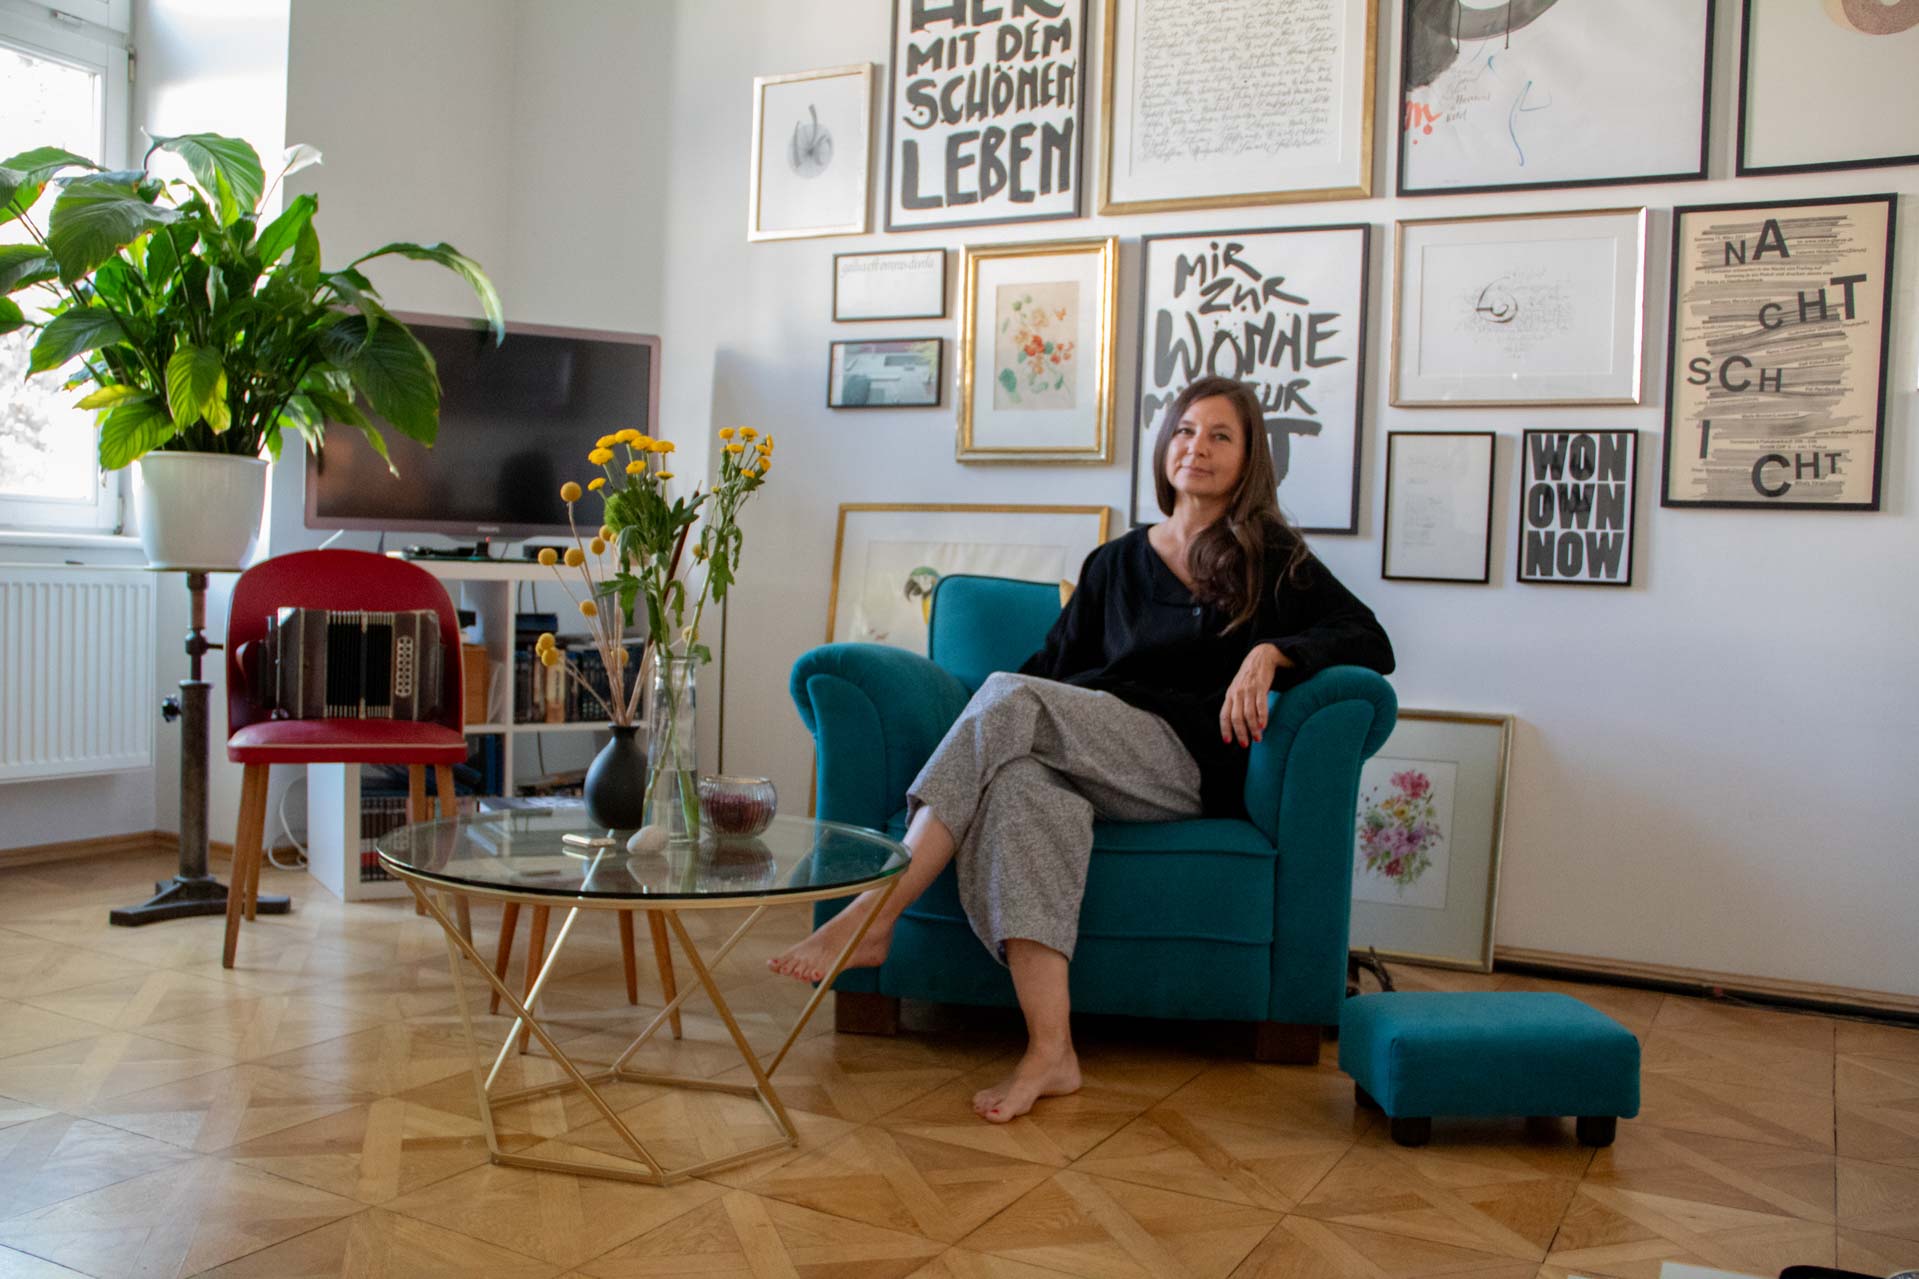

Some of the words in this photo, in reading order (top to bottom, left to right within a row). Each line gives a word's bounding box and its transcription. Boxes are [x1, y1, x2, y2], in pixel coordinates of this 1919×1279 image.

[907, 31, 981, 77] MIT
[996, 18, 1072, 62] DEM
[903, 58, 1077, 130] SCHÖNEN
[902, 117, 1075, 210] LEBEN
[1530, 433, 1628, 482] WON
[1528, 483, 1626, 530] OWN
[1526, 530, 1625, 579] NOW
